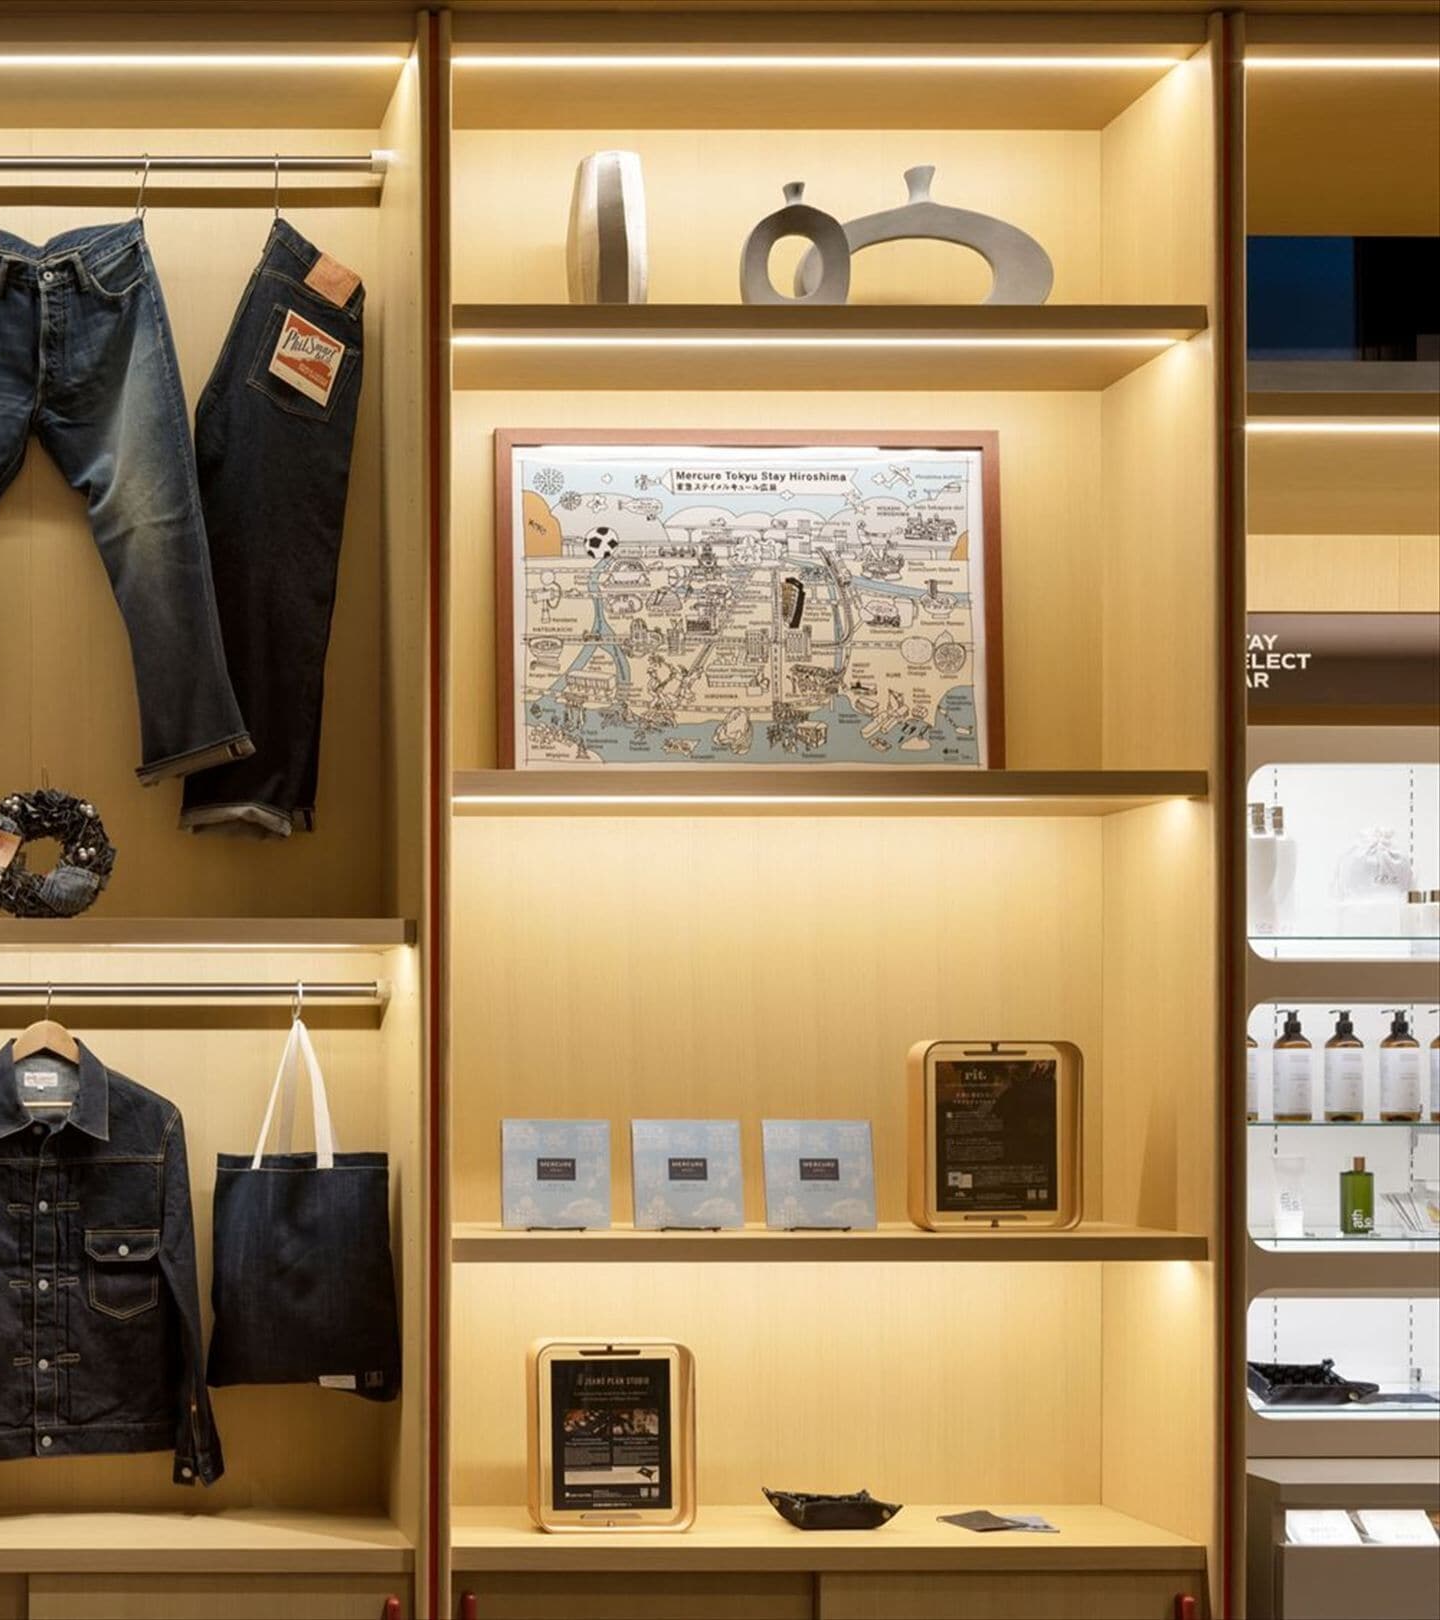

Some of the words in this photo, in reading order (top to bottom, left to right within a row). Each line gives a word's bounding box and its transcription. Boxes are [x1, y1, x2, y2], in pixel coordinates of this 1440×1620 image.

[676, 471, 721, 480] Mercure
[726, 471, 758, 483] Tokyu
[761, 471, 785, 482] Stay
[789, 472, 847, 481] Hiroshima
